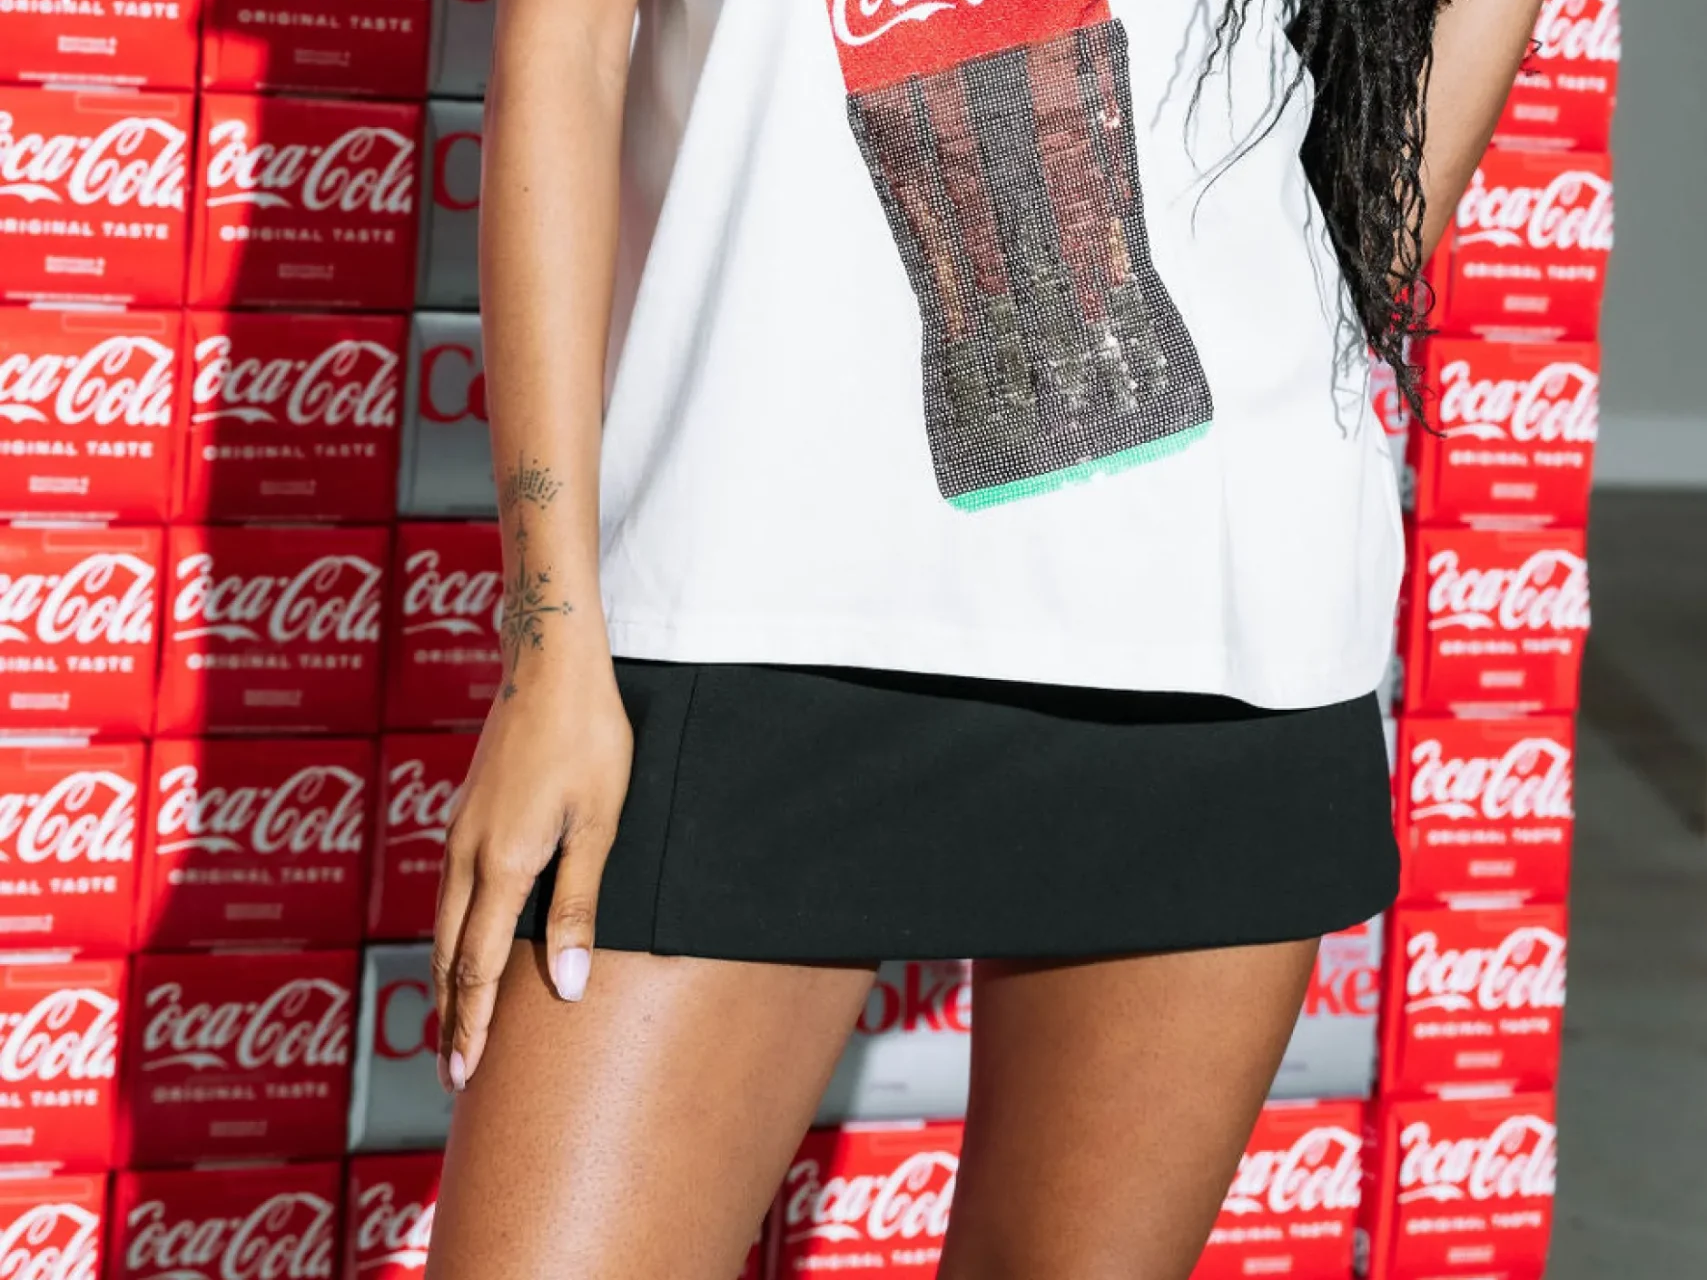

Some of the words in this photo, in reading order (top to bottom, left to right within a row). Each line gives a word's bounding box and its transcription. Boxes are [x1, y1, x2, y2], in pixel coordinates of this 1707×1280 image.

[113, 1, 179, 19] TASTE
[0, 111, 186, 209] ca-Cola
[0, 218, 93, 236] RIGINAL
[103, 221, 168, 239] TASTE
[1453, 168, 1614, 251] oca-Cola
[0, 336, 174, 426] ca-Cola
[0, 440, 77, 456] IGINAL
[87, 441, 152, 457] TASTE
[0, 552, 155, 643] a-Cola
[67, 656, 133, 672] TASTE
[857, 962, 971, 1035] oke
[785, 1151, 959, 1243] oca-Col
